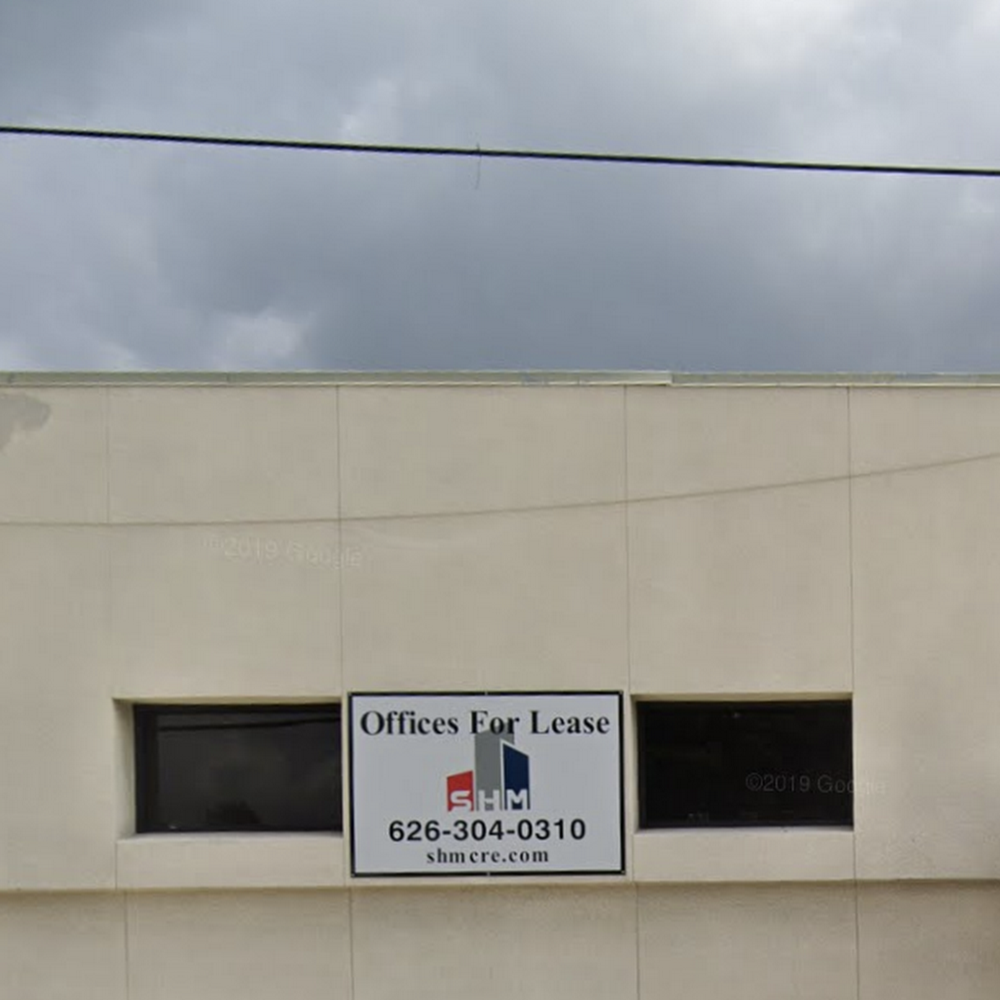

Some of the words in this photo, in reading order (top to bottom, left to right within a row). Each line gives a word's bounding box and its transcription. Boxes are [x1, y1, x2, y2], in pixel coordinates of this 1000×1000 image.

[360, 709, 460, 736] Offices
[469, 709, 520, 735] For
[530, 709, 610, 735] Lease
[447, 788, 531, 812] SHM
[388, 818, 587, 842] 626-304-0310
[426, 847, 550, 864] shmcre.com
